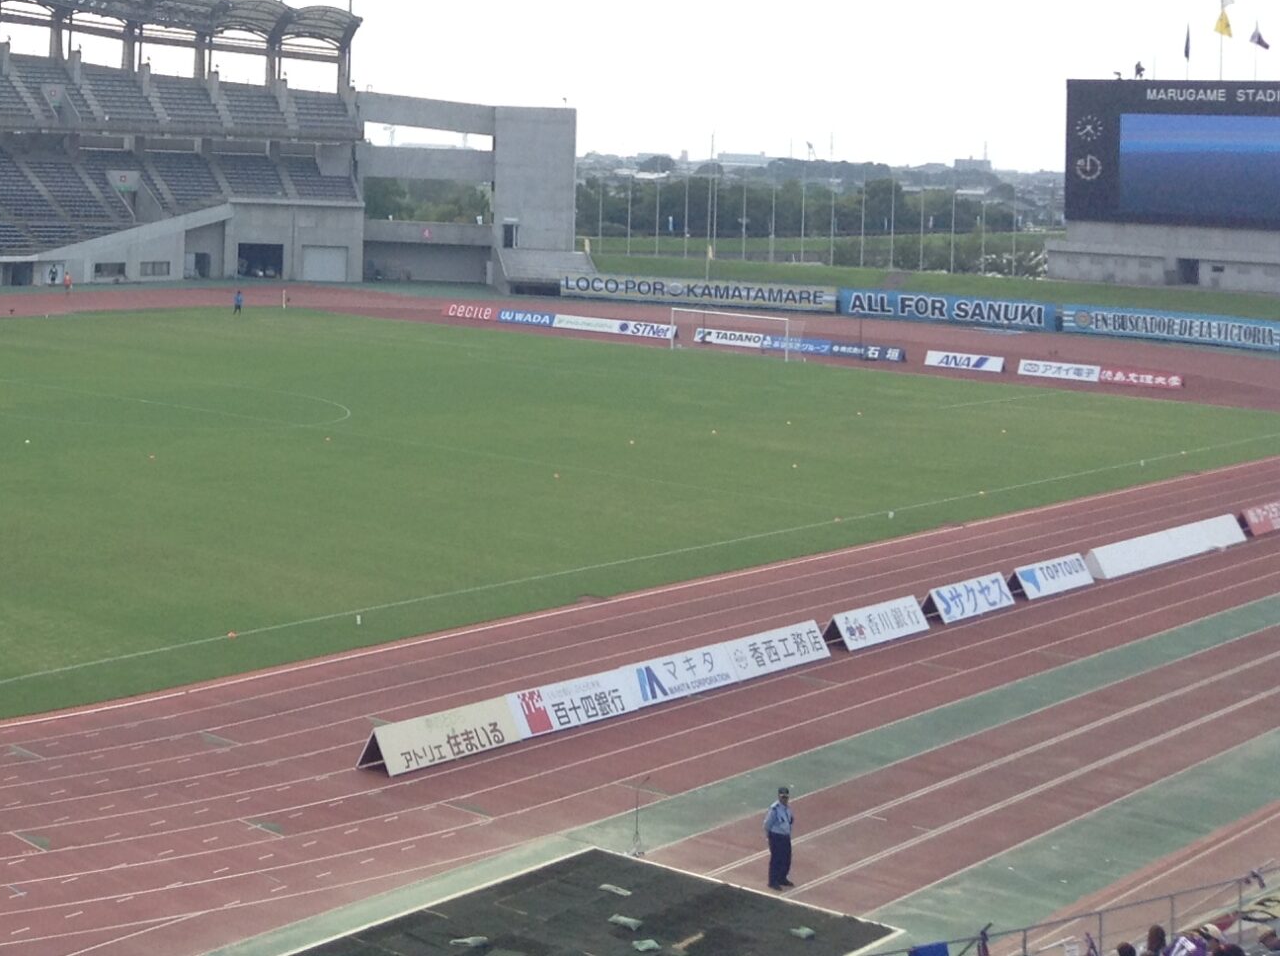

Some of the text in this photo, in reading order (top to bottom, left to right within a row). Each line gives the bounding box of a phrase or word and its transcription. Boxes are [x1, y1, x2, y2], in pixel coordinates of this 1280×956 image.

[1146, 88, 1227, 102] MARUGAME
[565, 275, 825, 306] LOCO POR KAMATAMARE
[514, 310, 550, 325] WADA
[850, 293, 1045, 326] ALL FOR SANUKI
[631, 322, 670, 337] STNet
[715, 331, 761, 343] TADANO
[1094, 312, 1274, 346] EN BUSCADOR DE LA VICTORIA
[937, 354, 971, 368] ANA
[1041, 364, 1097, 378] アオイ電子
[1039, 557, 1086, 581] TOPTOUR
[867, 603, 920, 636] 香川銀行
[748, 628, 825, 668] 香西工務店
[662, 651, 715, 680] マキタ
[551, 688, 626, 726] 百十四銀行
[400, 721, 505, 770] アトリエ 住まいる
